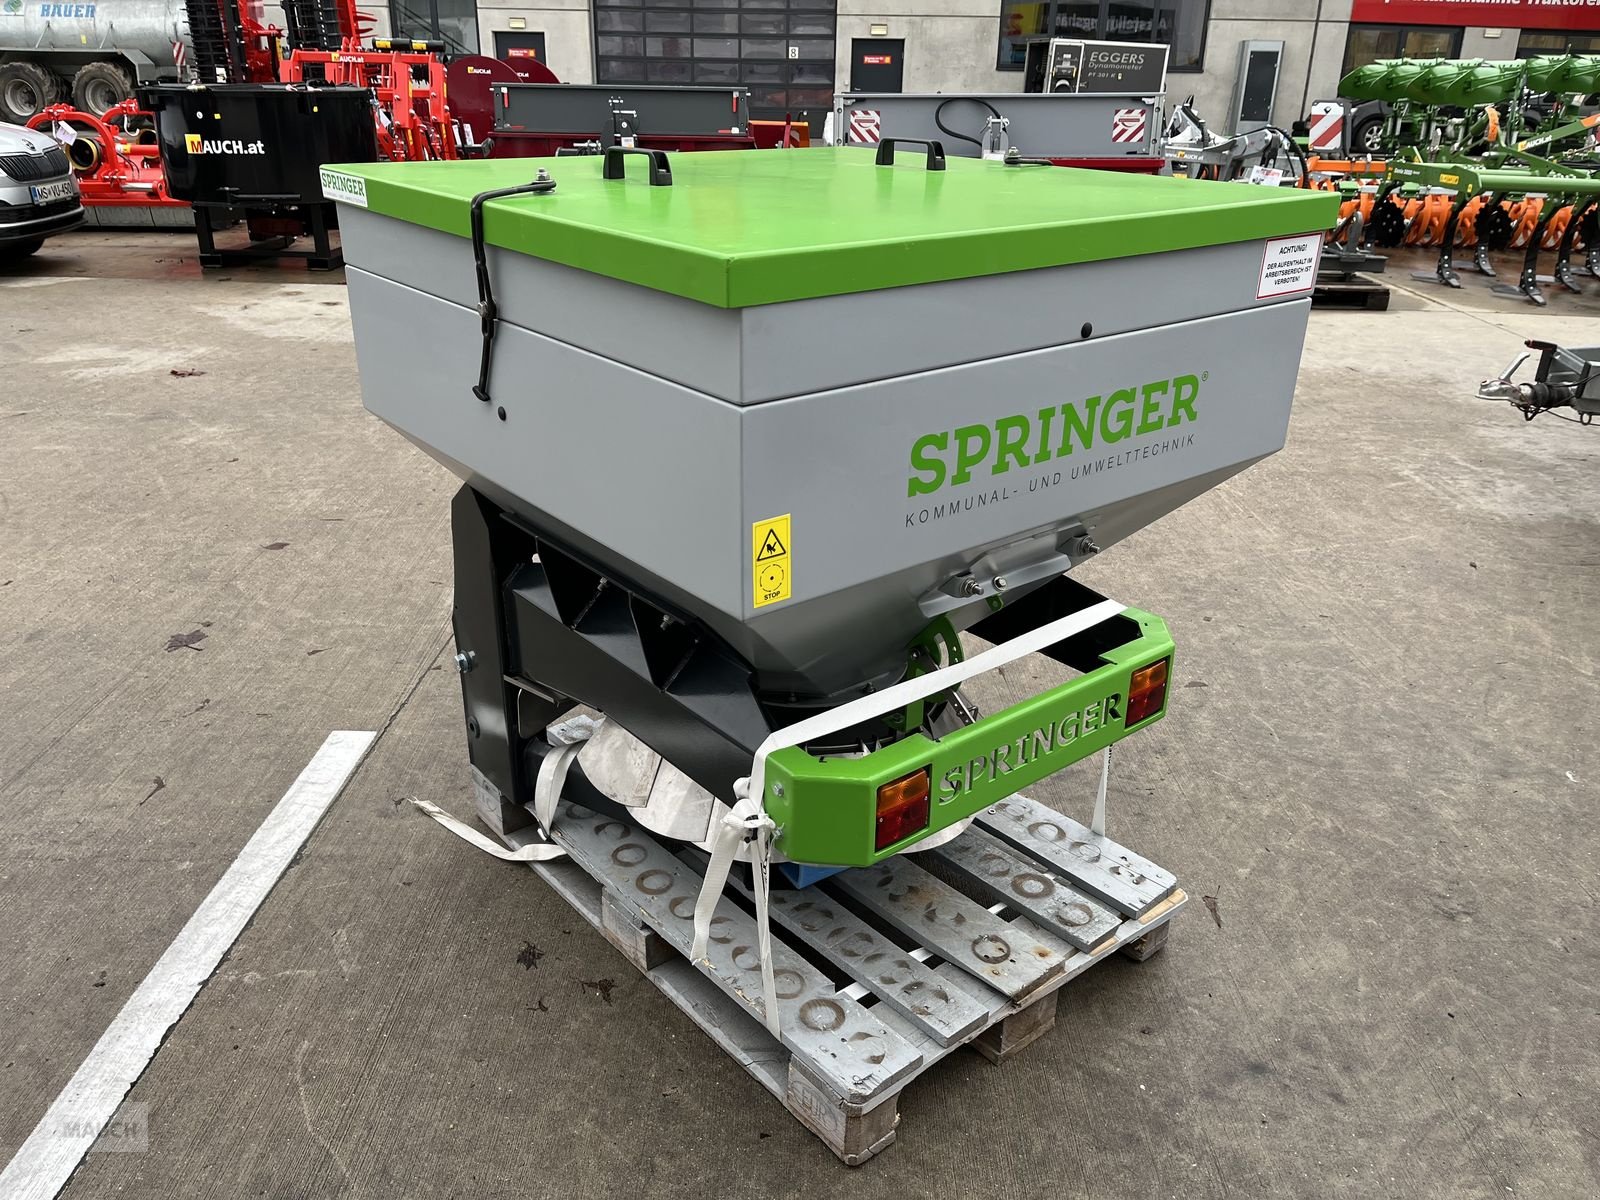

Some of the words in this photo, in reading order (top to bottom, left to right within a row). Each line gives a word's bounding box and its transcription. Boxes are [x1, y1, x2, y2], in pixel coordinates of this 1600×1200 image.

[791, 48, 797, 58] 8
[1090, 51, 1145, 64] EGGERS
[1088, 61, 1142, 71] Dynamometer
[190, 139, 265, 154] MAUCH.at
[321, 172, 365, 197] SPRINGER
[1279, 244, 1307, 254] ACHTUNG!
[1267, 262, 1278, 270] DER
[1278, 258, 1307, 268] AUFENTHALT
[1265, 268, 1304, 278] ARBEITSBEREICH
[1275, 276, 1300, 285] VERBOTEN!
[904, 487, 1019, 528] KOMMUNAL-
[1028, 472, 1062, 493] UND
[1070, 433, 1195, 480] UMWELTTECHNIK
[764, 590, 781, 601] STOP
[938, 693, 1122, 807] SPRINGER
